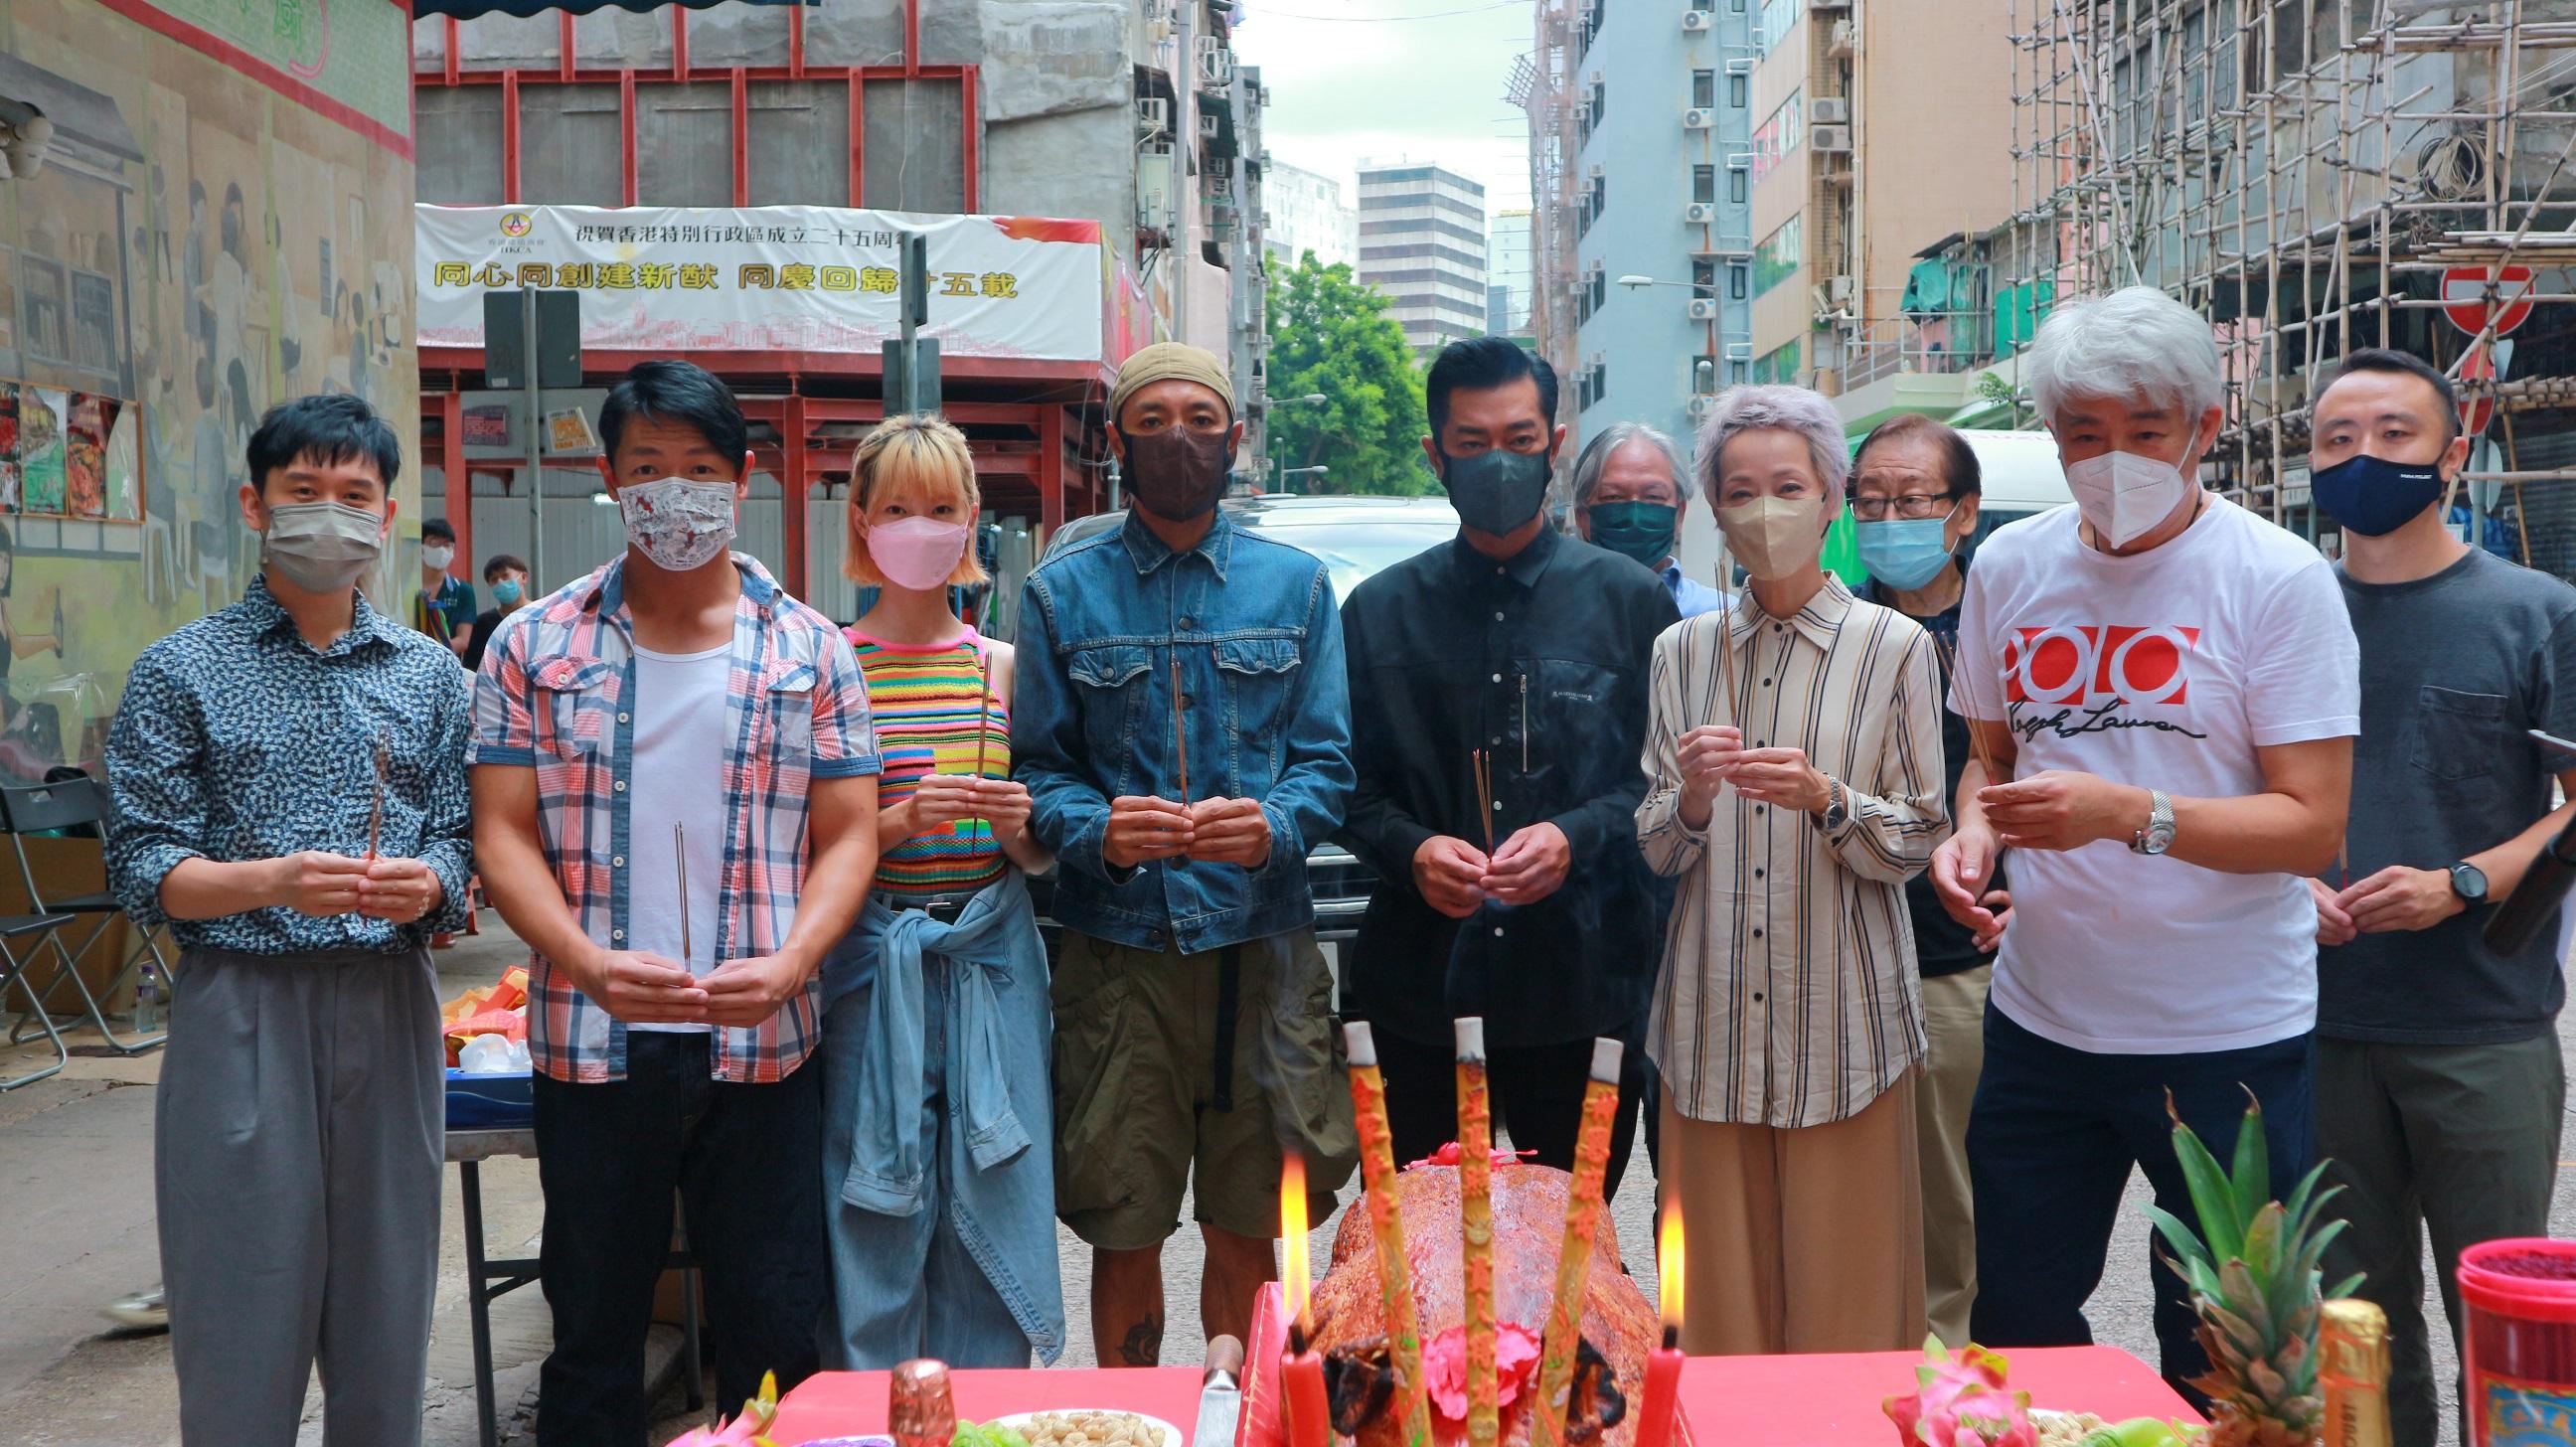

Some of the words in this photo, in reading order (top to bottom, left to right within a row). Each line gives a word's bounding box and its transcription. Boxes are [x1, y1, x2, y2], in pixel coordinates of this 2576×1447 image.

[434, 260, 720, 289] 同心同創建新猷
[2059, 695, 2207, 739] Lauren
